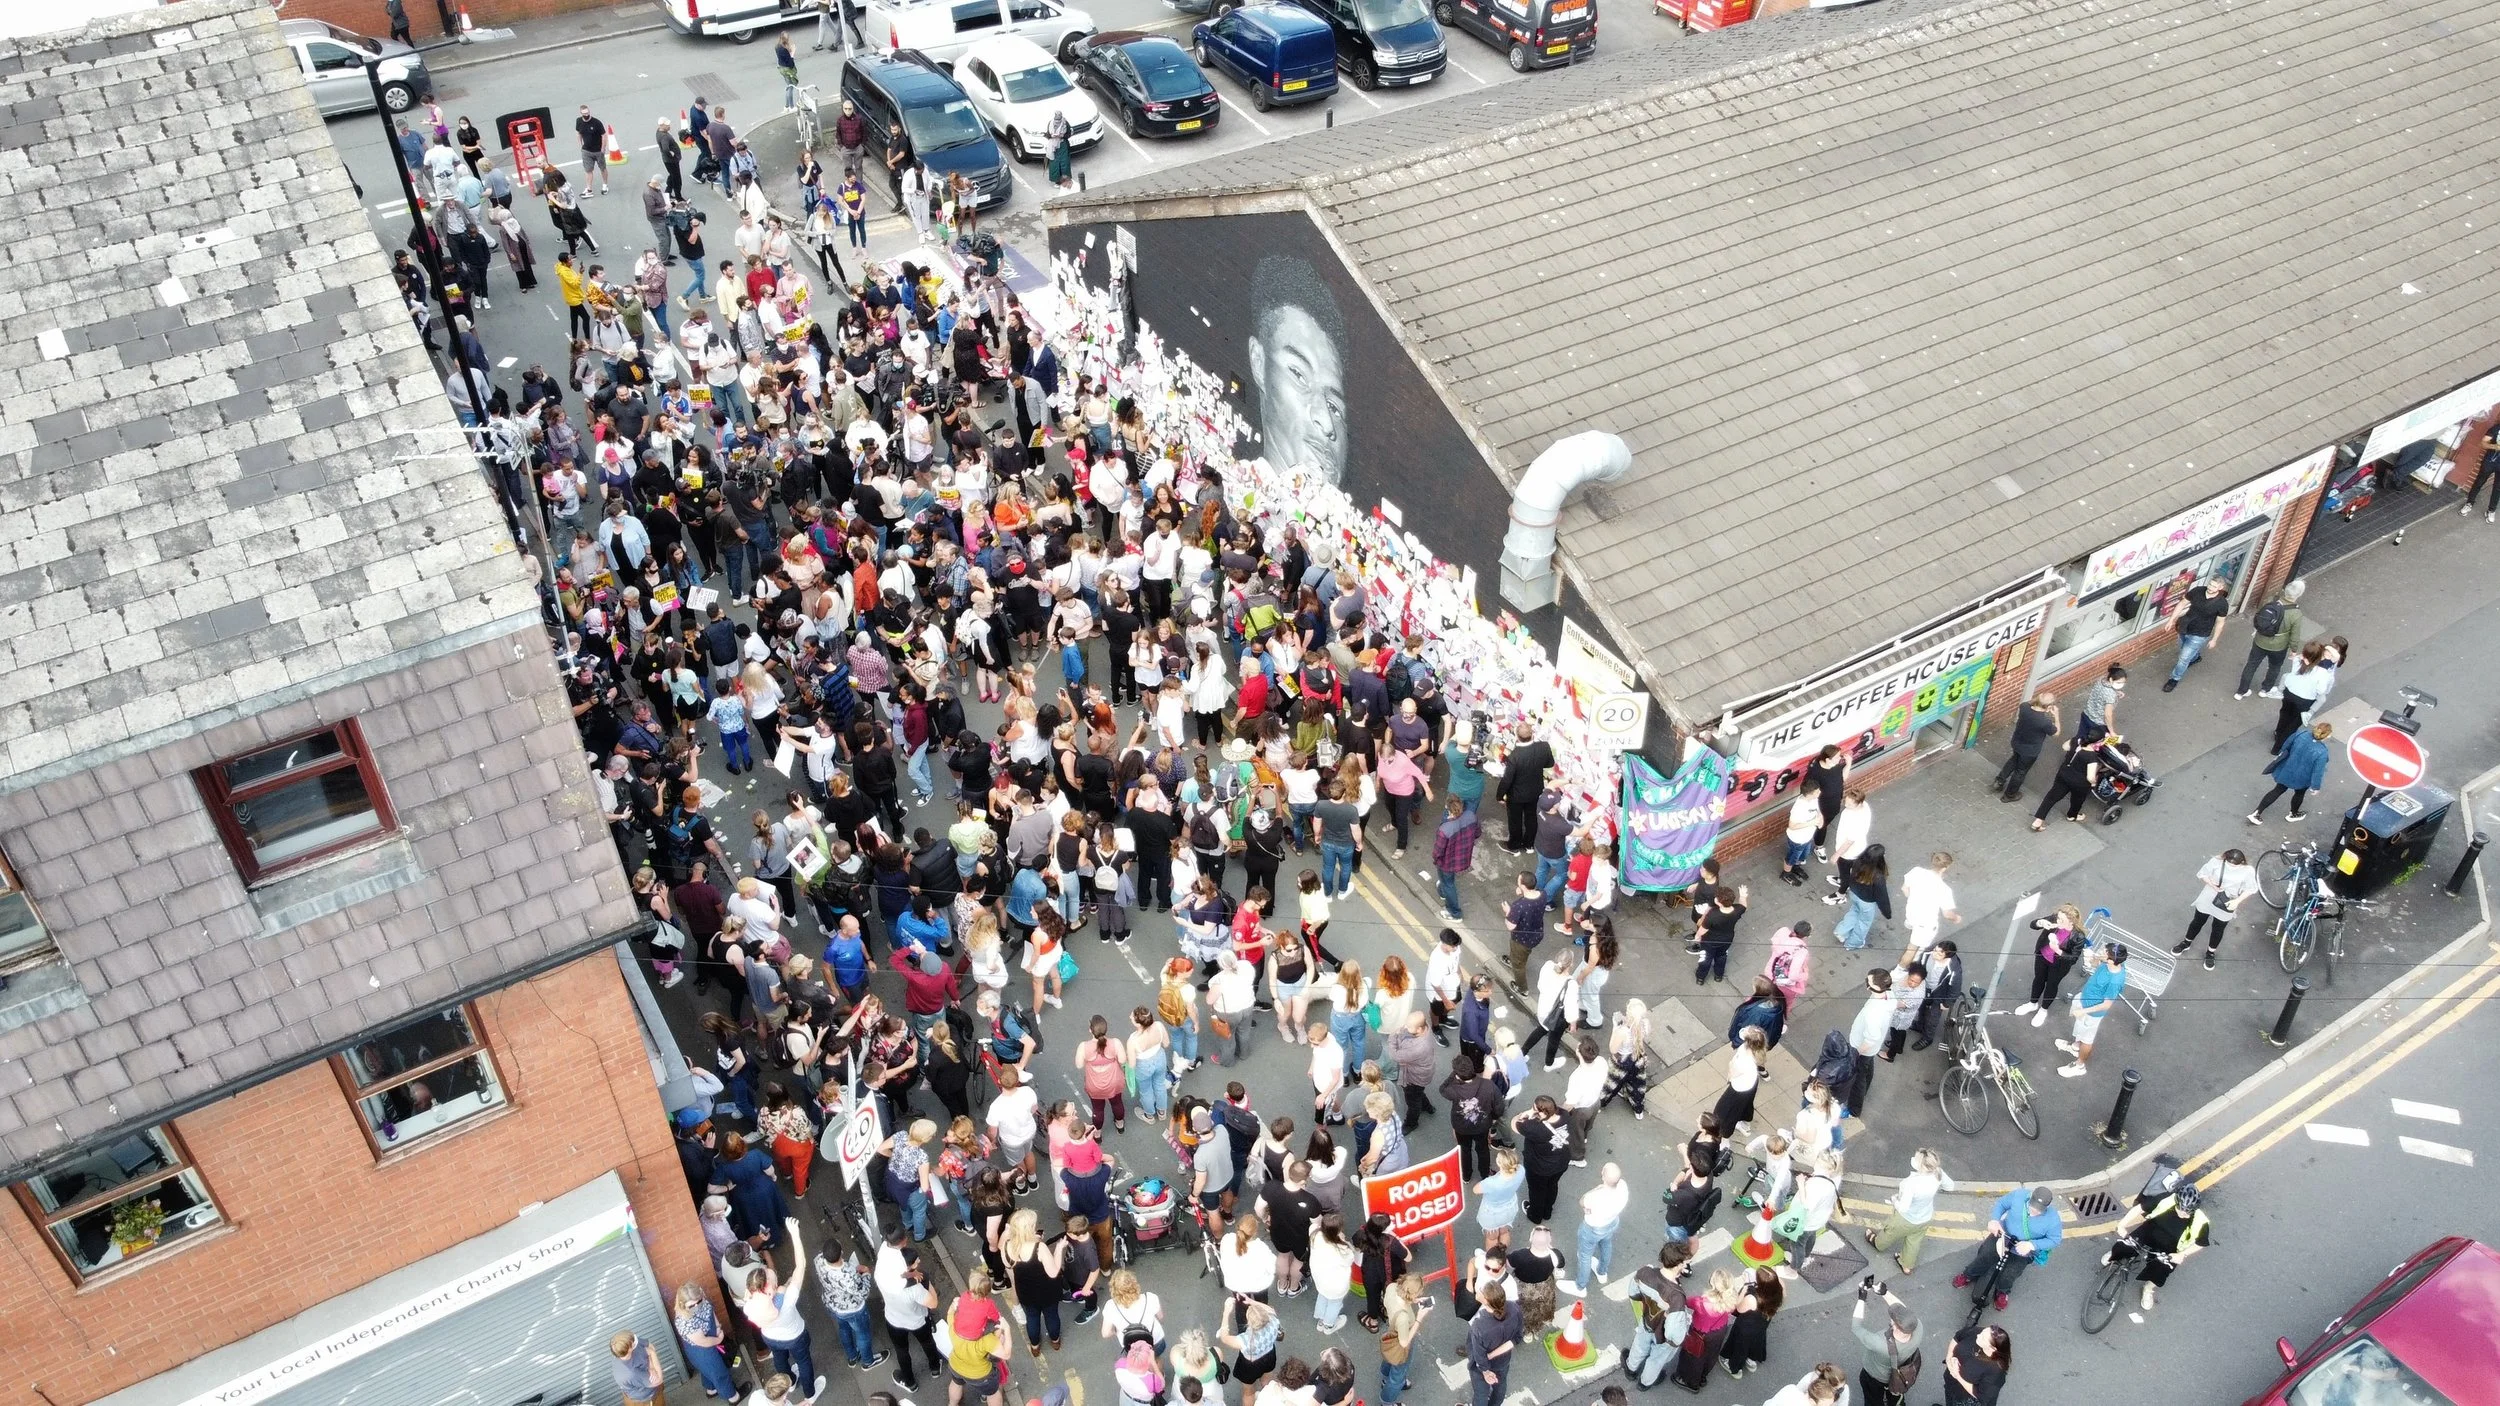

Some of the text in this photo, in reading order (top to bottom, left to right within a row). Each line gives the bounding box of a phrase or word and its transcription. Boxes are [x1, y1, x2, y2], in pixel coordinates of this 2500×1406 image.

[1234, 413, 1252, 442] play
[2181, 489, 2248, 526] COPSON NEWS
[1566, 624, 1631, 682] Coffee House Cafe
[1759, 721, 1804, 754] THE
[1811, 678, 1899, 730] COFFEE
[1985, 611, 2039, 652] CAFE
[1604, 708, 1634, 722] 20
[1595, 736, 1634, 746] ZONE
[851, 1142, 878, 1180] ZONE
[1388, 1171, 1447, 1204] ROAD
[216, 1235, 576, 1404] Your Local Independent Charity Shop
